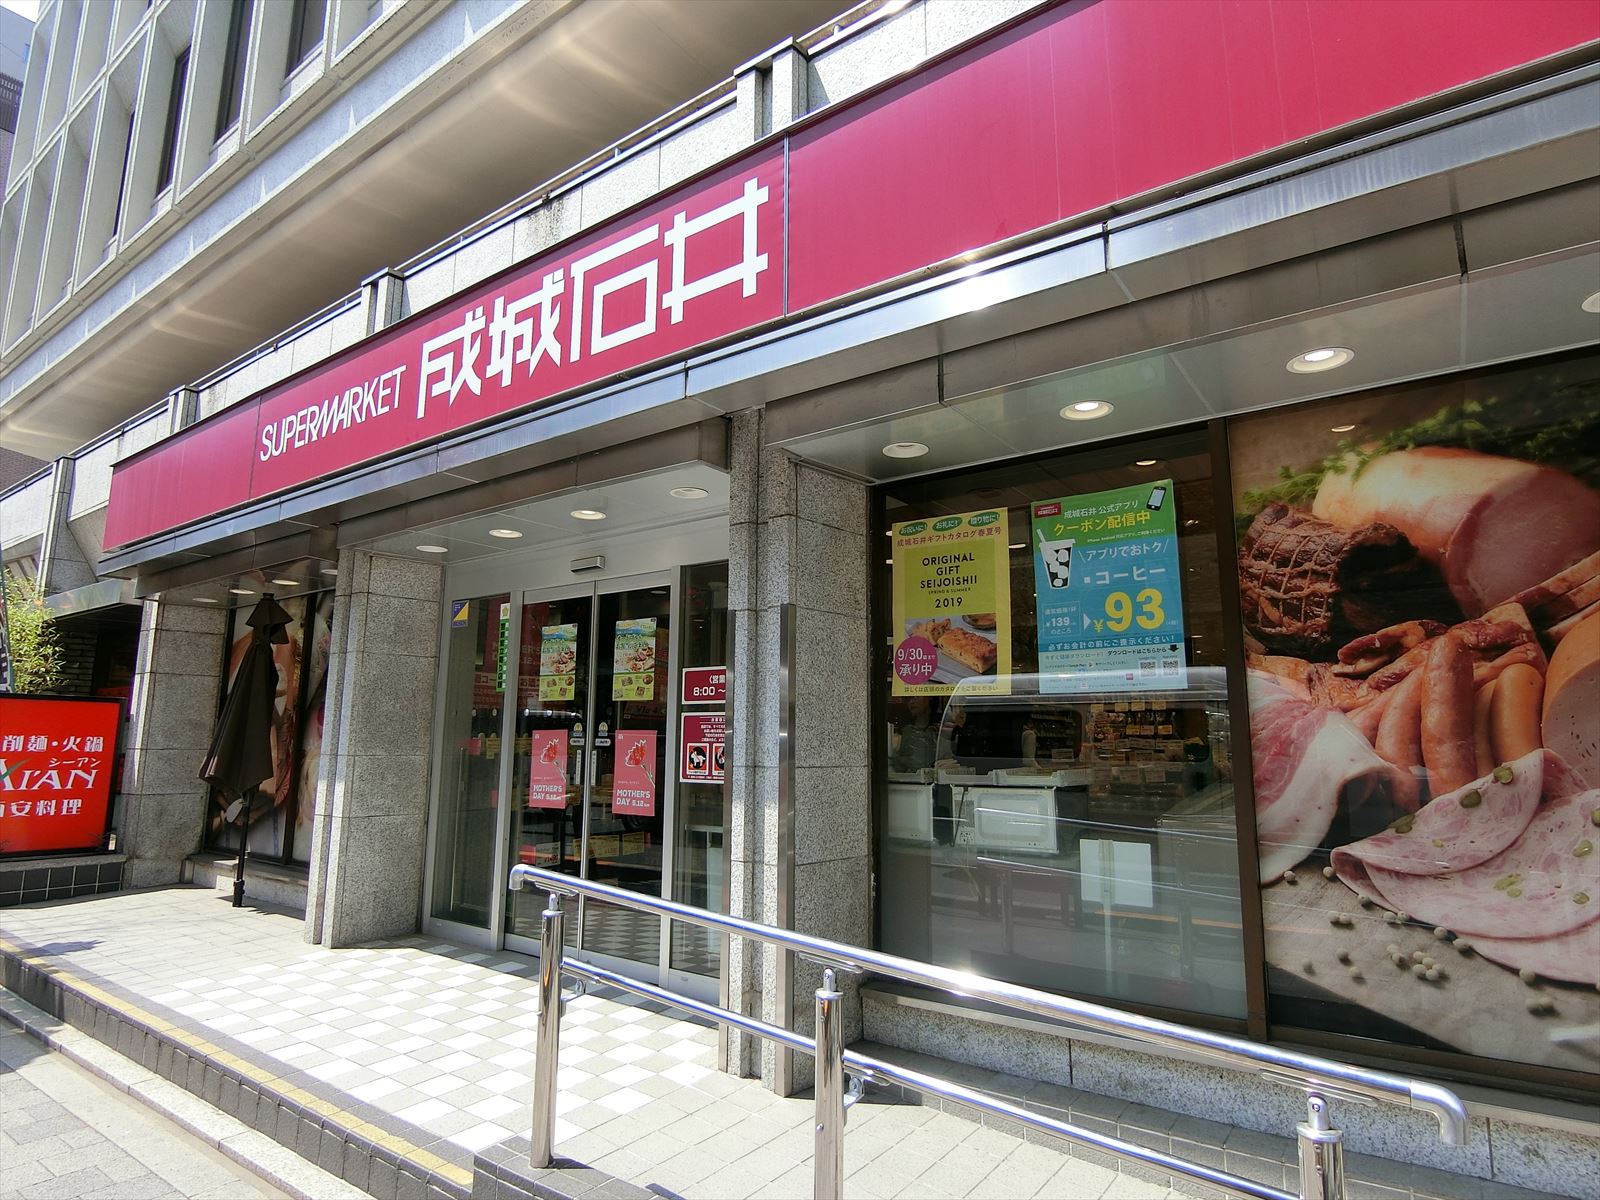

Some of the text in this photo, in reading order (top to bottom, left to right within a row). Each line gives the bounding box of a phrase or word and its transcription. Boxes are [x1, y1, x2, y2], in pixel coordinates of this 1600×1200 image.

[260, 177, 768, 461] SUPERMARKET 成城石井
[1064, 500, 1139, 519] 成城石井 公式アプリ
[1054, 510, 1150, 536] クーポン配信中
[897, 527, 1001, 547] 成城石井ギフトカタログ春夏号
[1086, 542, 1161, 561] アプリでおトク
[922, 552, 975, 567] ORIGINAL
[936, 565, 961, 576] GIFT
[920, 575, 977, 589] SEIJOISHII
[934, 597, 963, 609] 2019
[1108, 646, 1167, 656] ダウンロードはこちらから
[899, 662, 932, 677] 承り中
[49, 757, 101, 768] シーアン
[533, 784, 563, 792] MOTHER'S
[617, 789, 650, 799] MOTHER'S
[532, 792, 545, 800] DAY
[617, 797, 631, 806] DAY
